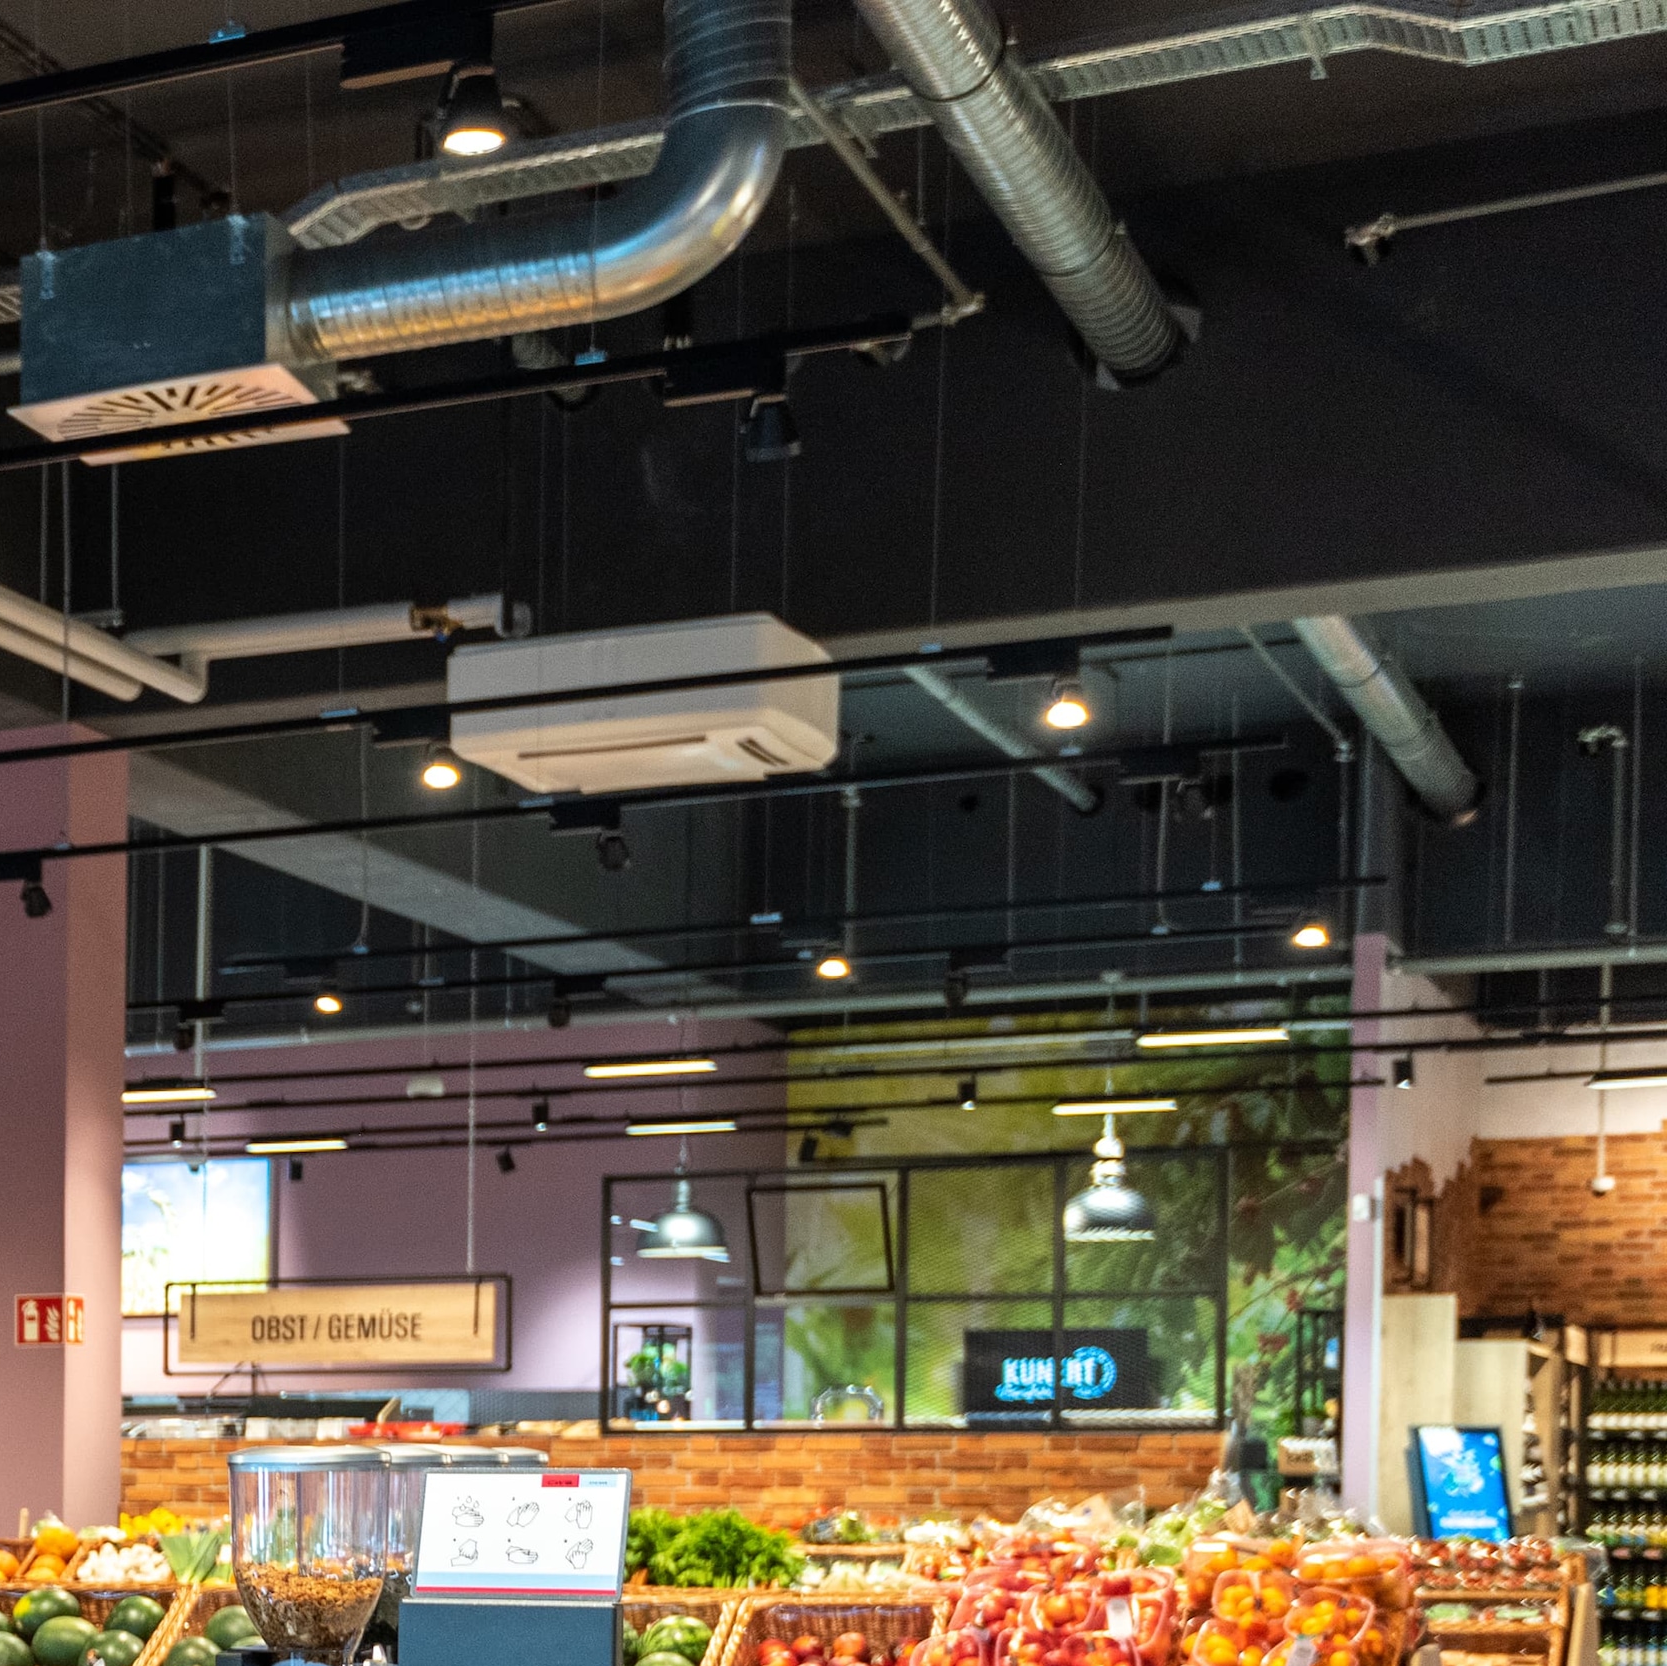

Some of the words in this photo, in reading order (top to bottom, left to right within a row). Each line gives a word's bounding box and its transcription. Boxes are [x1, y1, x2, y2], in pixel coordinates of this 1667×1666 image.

[251, 1314, 307, 1343] OBST
[313, 1314, 321, 1340] /
[328, 1308, 423, 1342] GEMÜSE
